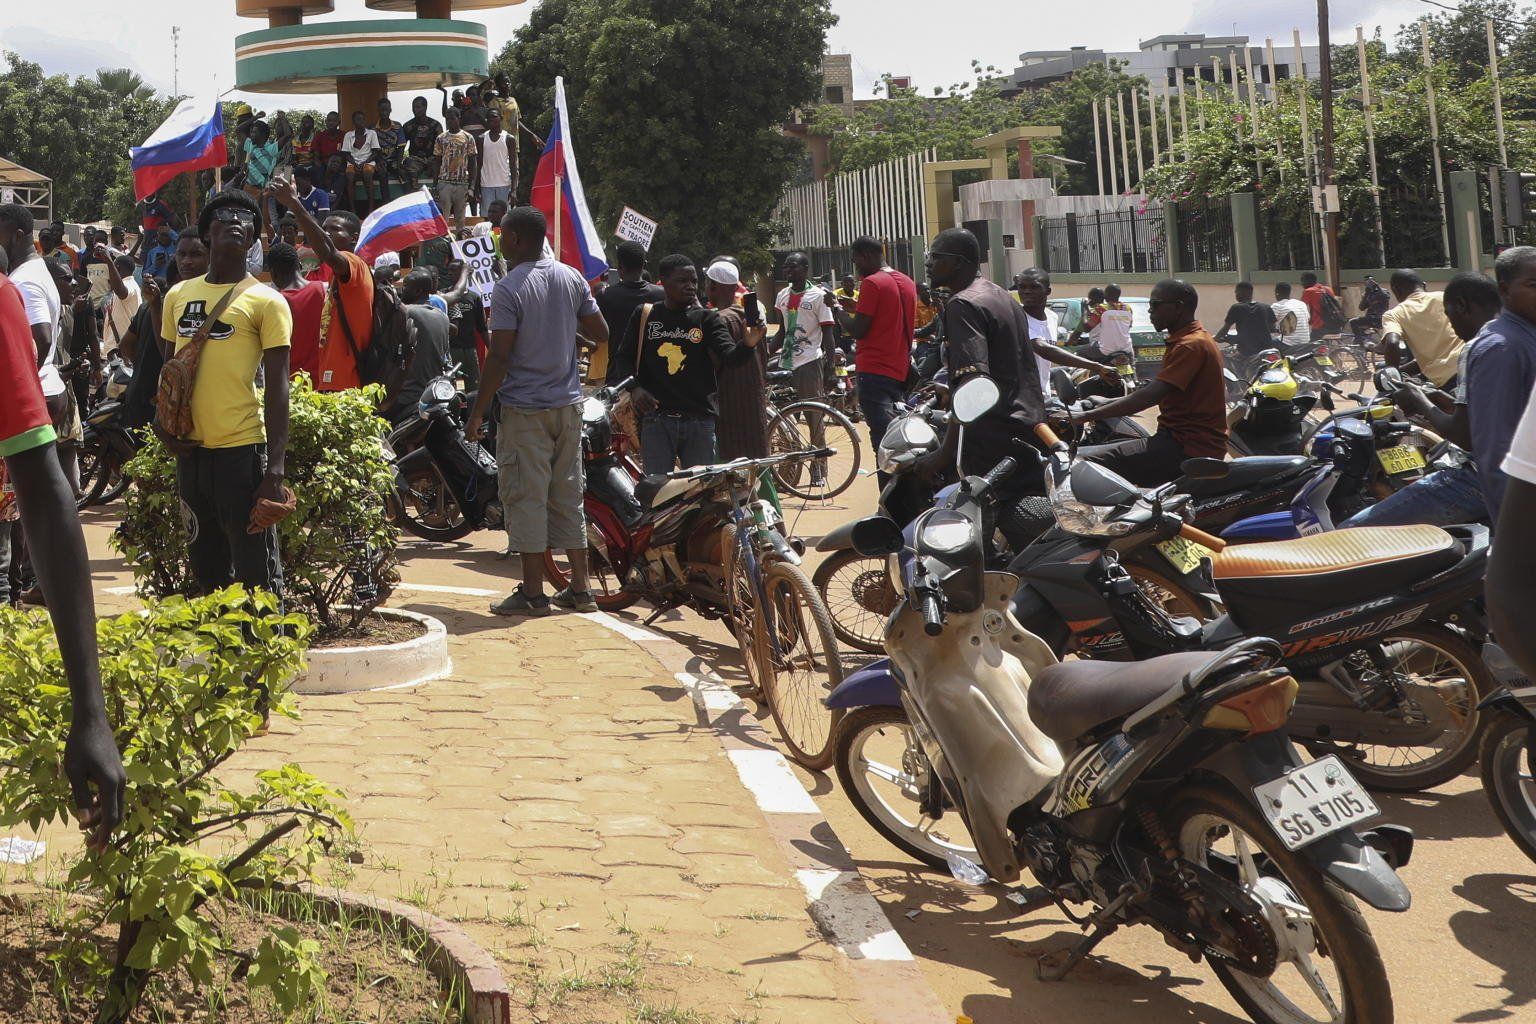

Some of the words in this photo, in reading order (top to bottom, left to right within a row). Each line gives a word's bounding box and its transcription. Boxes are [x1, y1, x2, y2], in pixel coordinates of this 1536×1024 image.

[624, 211, 654, 233] SOUTIEN
[1287, 773, 1319, 799] 11
[1280, 812, 1315, 842] SG
